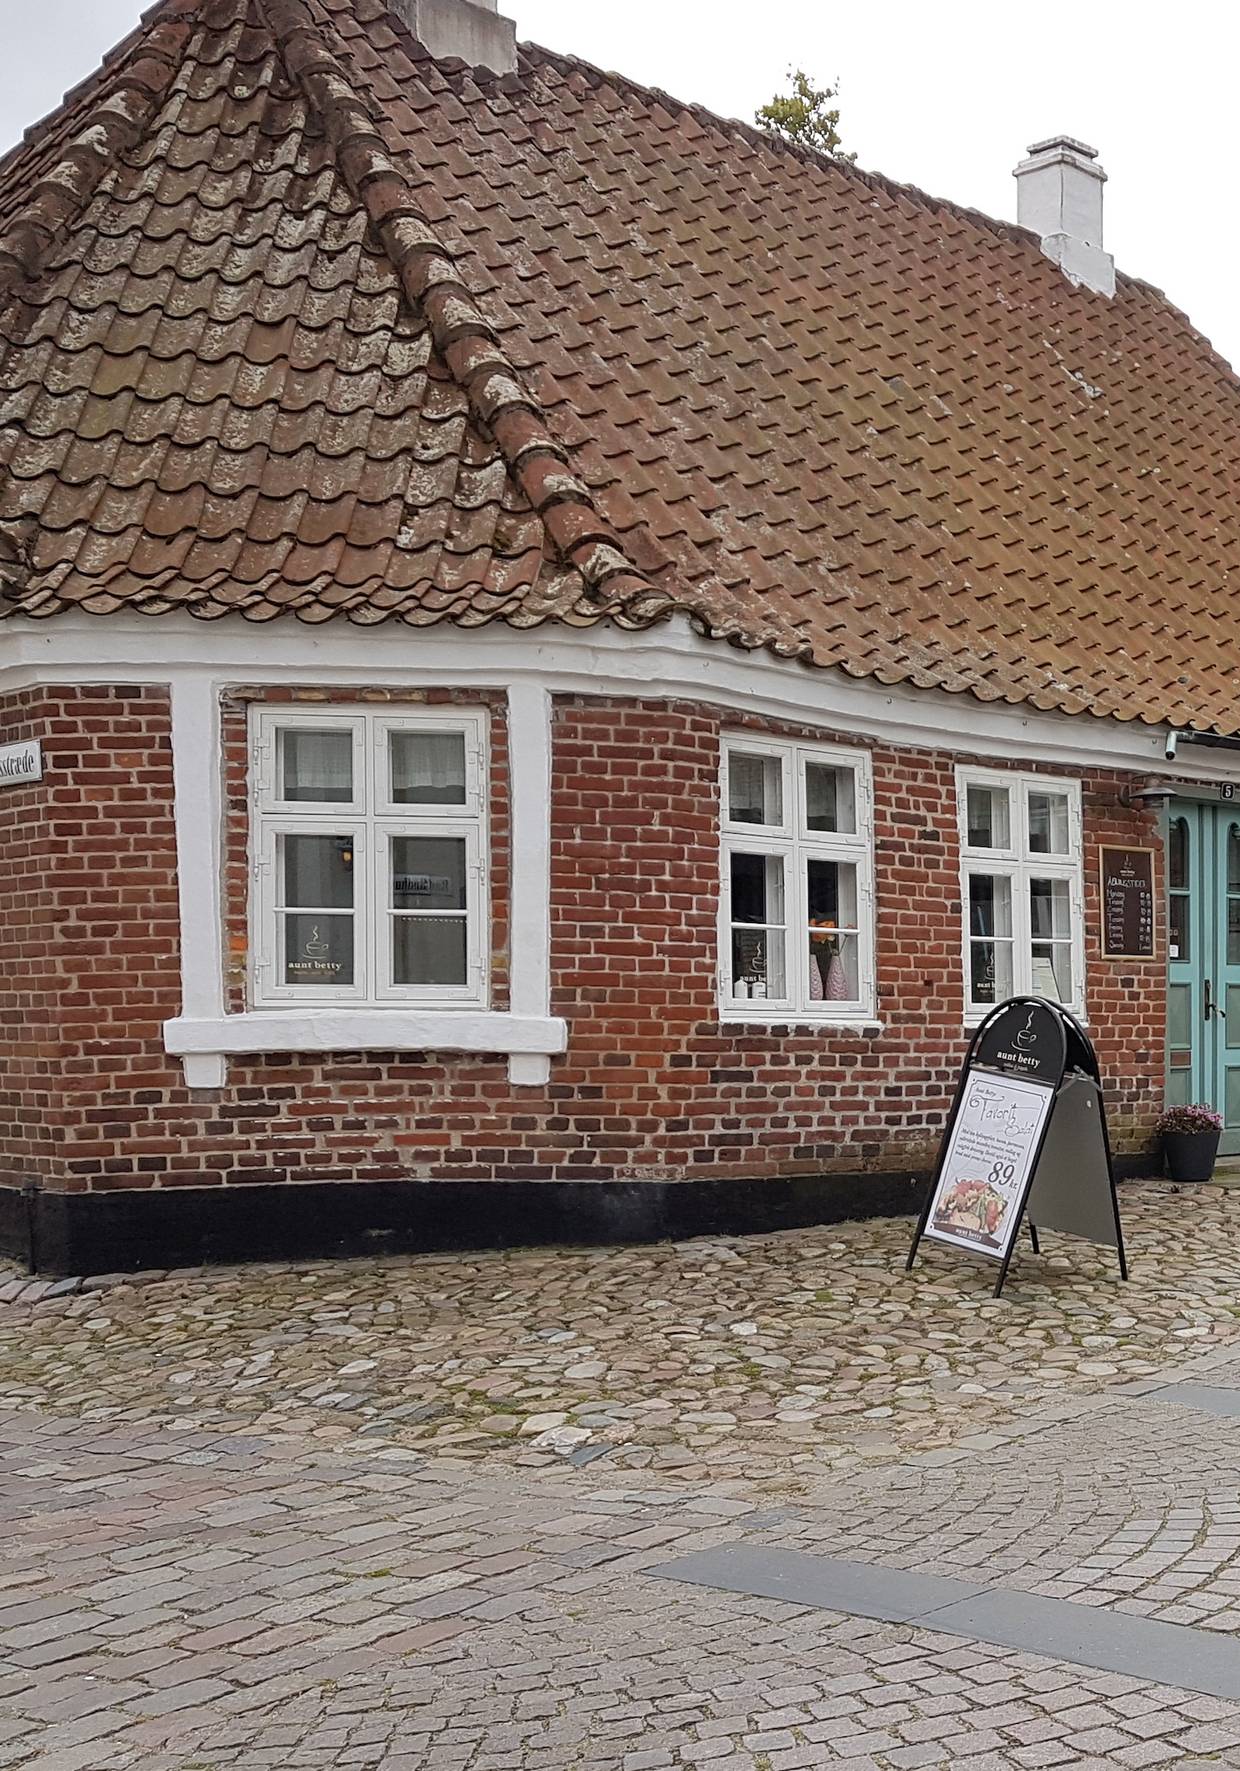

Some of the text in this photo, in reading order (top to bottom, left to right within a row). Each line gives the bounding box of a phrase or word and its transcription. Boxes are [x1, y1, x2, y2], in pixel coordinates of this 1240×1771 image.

[1225, 785, 1232, 798] 5
[288, 960, 342, 971] aunt betty
[997, 1051, 1017, 1061] aunt
[1018, 1053, 1041, 1069] betty
[988, 1161, 1015, 1186] 89
